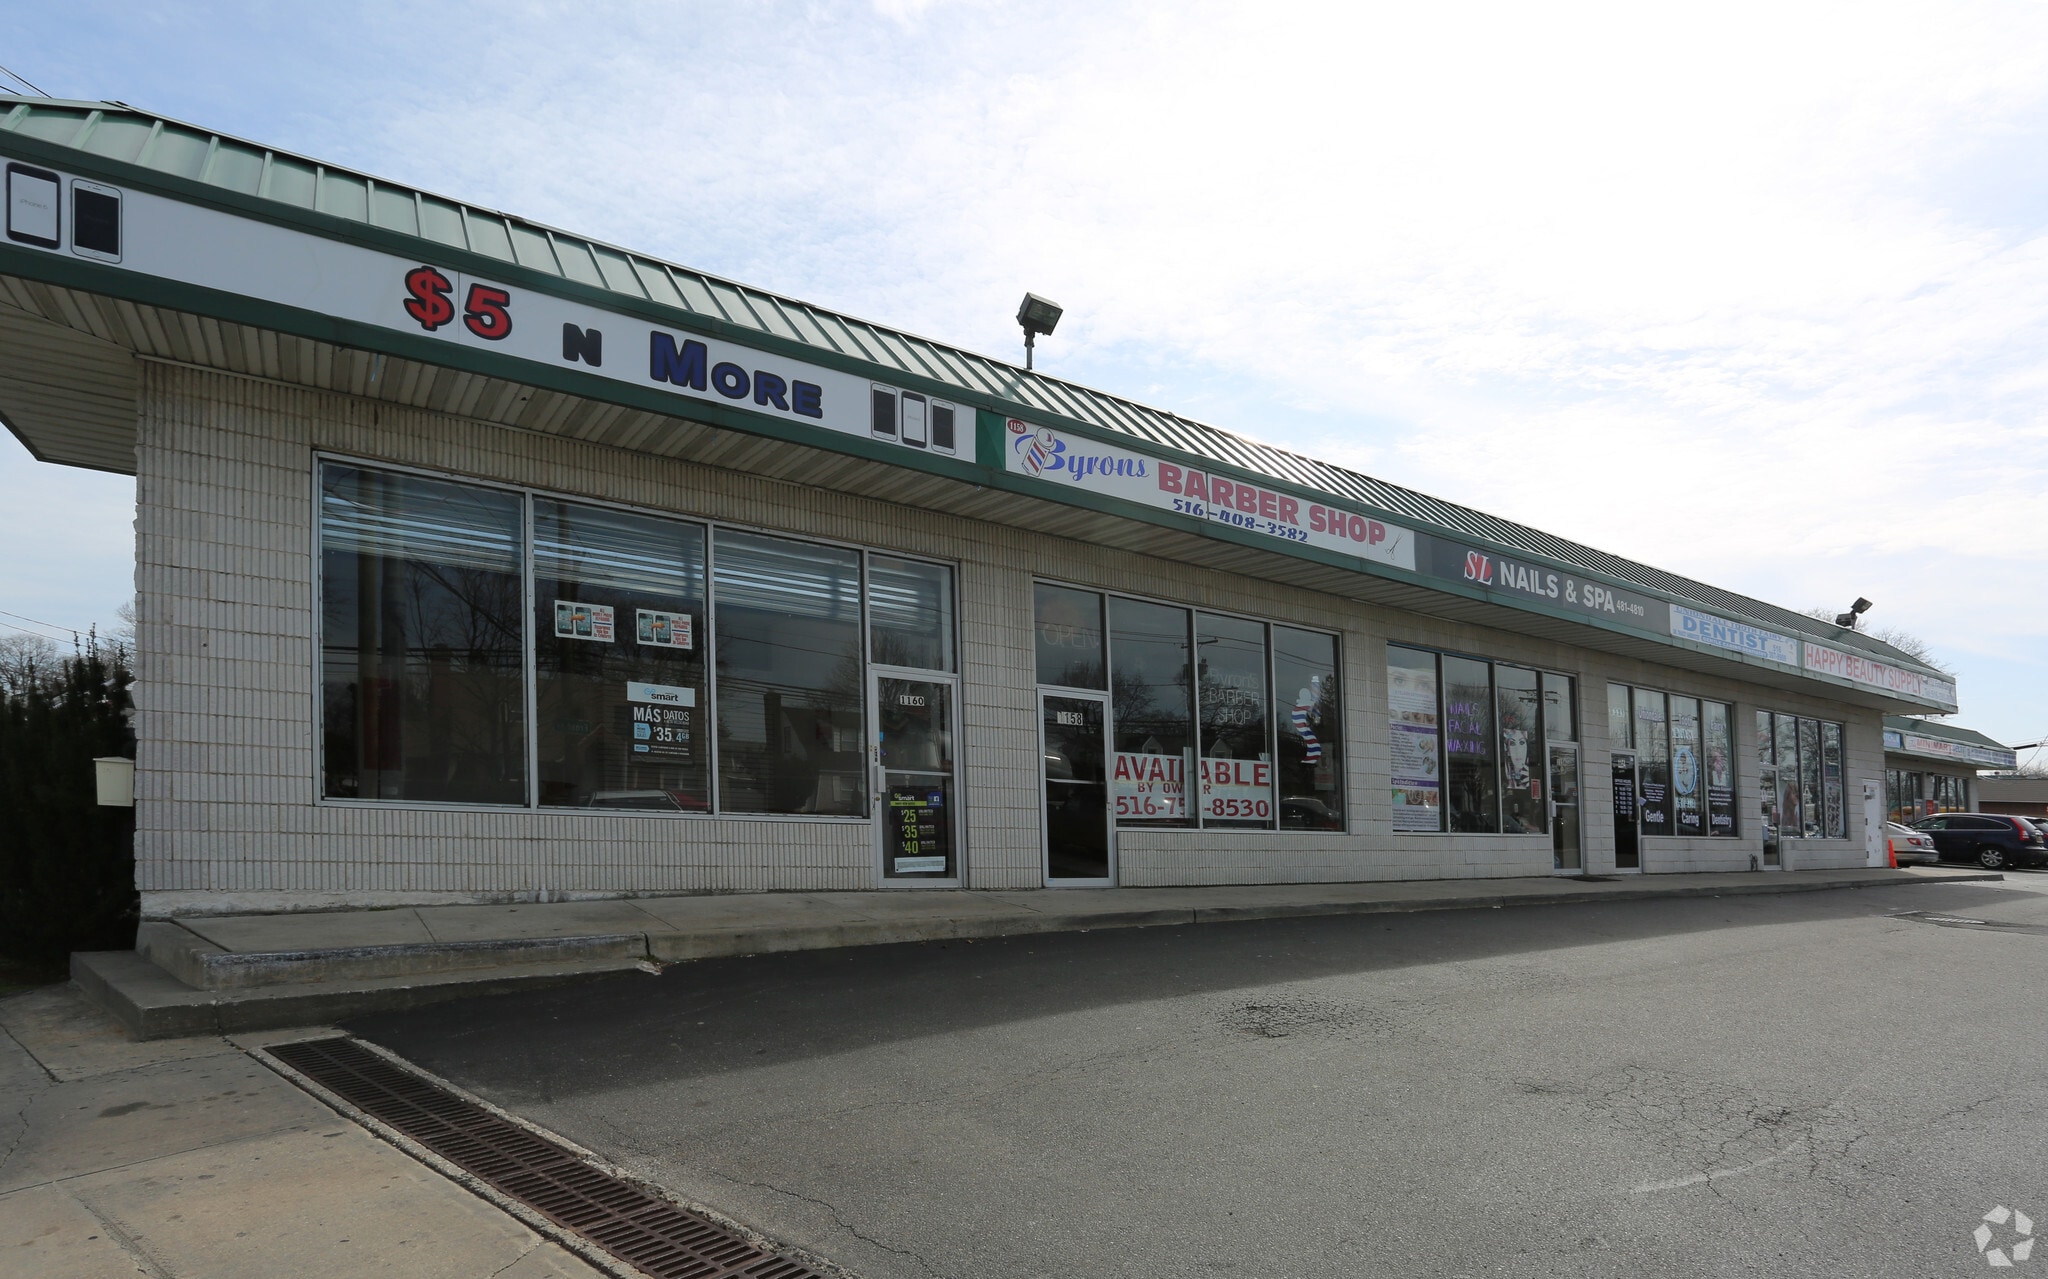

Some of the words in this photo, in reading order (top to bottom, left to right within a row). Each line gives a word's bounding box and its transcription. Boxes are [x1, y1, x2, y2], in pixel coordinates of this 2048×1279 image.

[403, 265, 512, 340] $5
[562, 322, 602, 367] N
[1009, 421, 1025, 434] 1158
[1158, 462, 1299, 526] BARBER
[1309, 504, 1386, 545] SHOP
[1172, 498, 1308, 543] 516-408-3582
[1500, 561, 1559, 599] NAILS
[1565, 579, 1578, 604] &
[1583, 584, 1616, 614] SPA
[1682, 616, 1768, 650] DENTIST
[1806, 644, 1844, 674] HAPPY
[1846, 655, 1887, 683] BEAUTY
[1889, 669, 1923, 695] SUPPLY
[651, 693, 679, 702] smart
[901, 696, 924, 706] 1160
[1209, 688, 1260, 707] BARBER
[633, 705, 661, 723] MÁS
[663, 710, 690, 722] DATOS
[1217, 706, 1252, 725] SHOP
[1448, 719, 1482, 735] FACAL
[1137, 782, 1154, 793] BY
[1163, 783, 1211, 795] OWR
[901, 809, 917, 822] $25
[1116, 796, 1269, 818] 516-7-8530
[1645, 809, 1664, 823] Gentle
[1682, 812, 1699, 827] Caring
[1711, 813, 1732, 828] Dentistry
[902, 825, 918, 838] $35
[902, 840, 919, 854] $40
